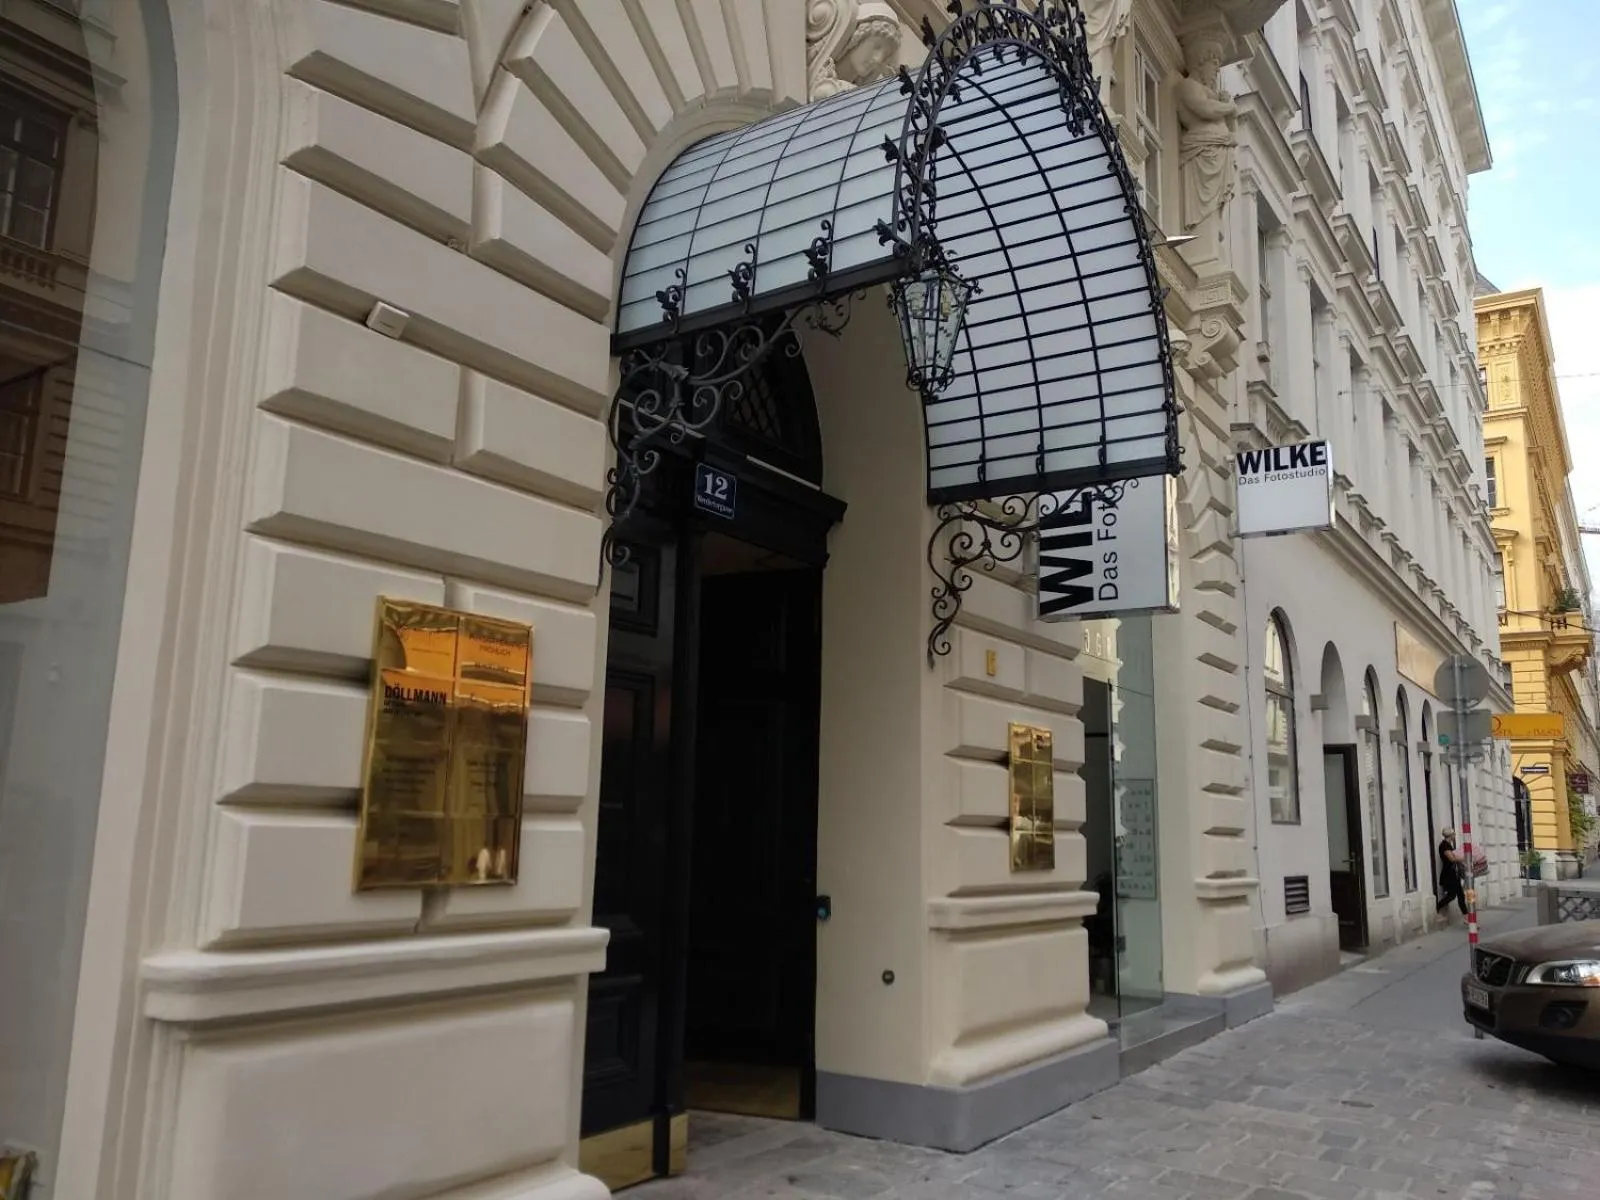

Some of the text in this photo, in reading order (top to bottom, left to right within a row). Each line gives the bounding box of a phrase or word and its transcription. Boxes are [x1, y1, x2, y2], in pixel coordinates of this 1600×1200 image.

[1237, 441, 1326, 475] WILKE
[704, 472, 728, 500] 12
[1239, 468, 1326, 486] Das Fotostudio
[1039, 491, 1094, 616] WIL
[1098, 551, 1118, 601] Das
[384, 682, 447, 706] DÖLLMANN
